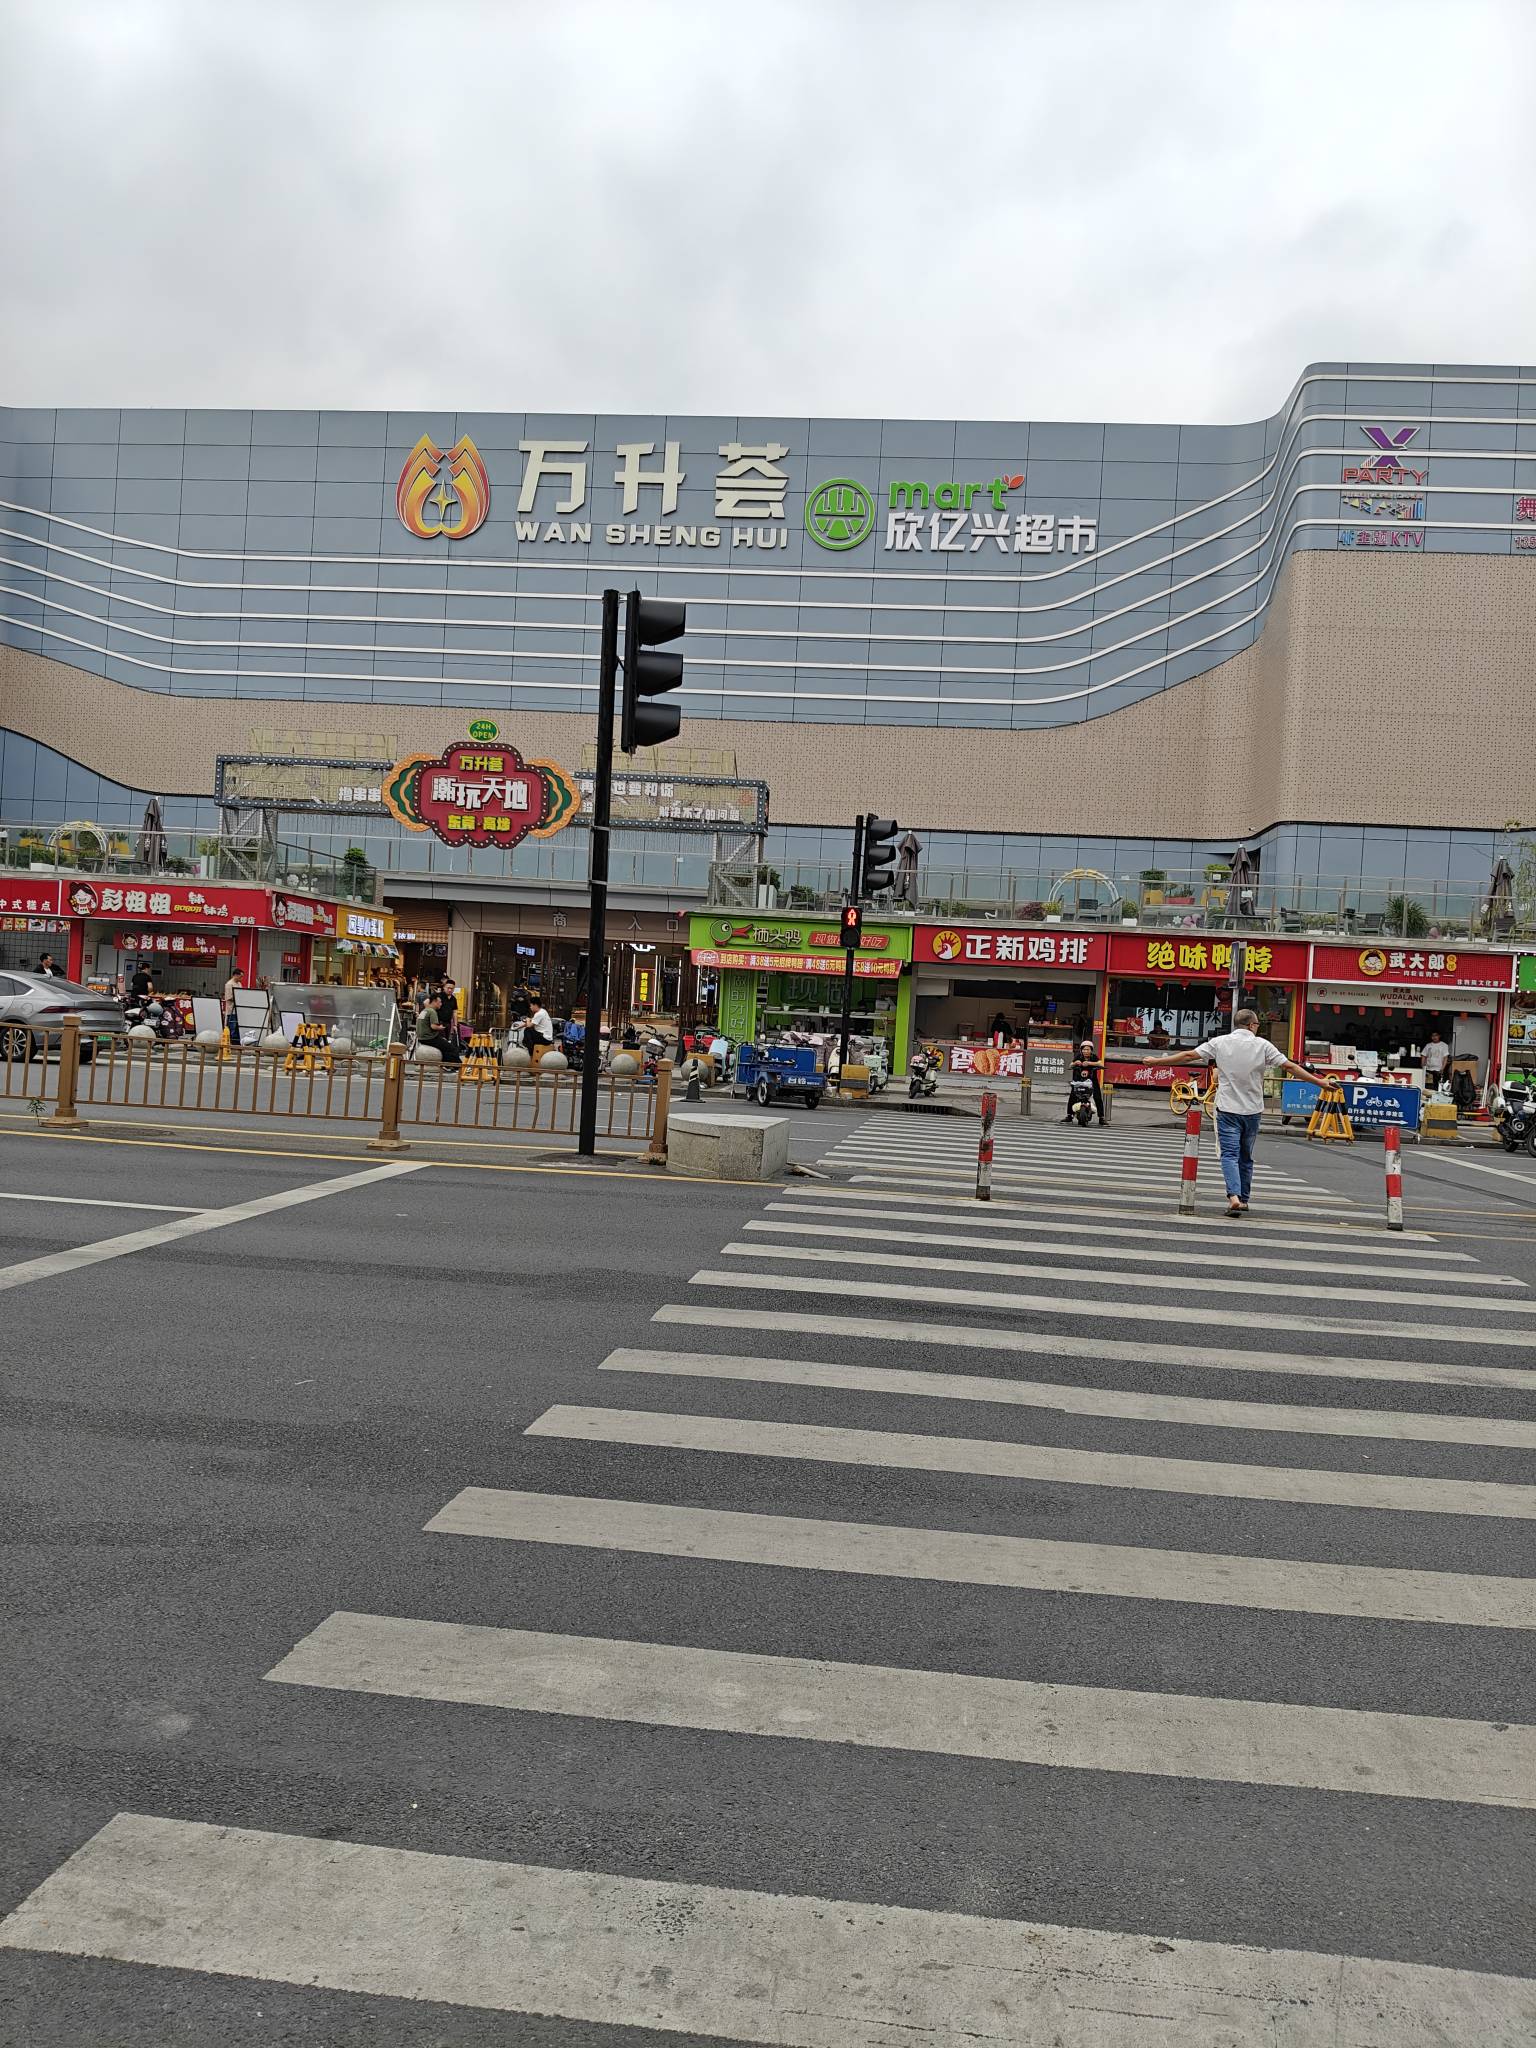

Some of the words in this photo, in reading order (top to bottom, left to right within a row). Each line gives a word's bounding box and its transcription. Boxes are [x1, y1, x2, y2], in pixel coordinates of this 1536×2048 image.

[517, 440, 790, 519] 万升荟
[1343, 468, 1428, 485] PARTY
[889, 477, 1008, 511] mart
[516, 521, 591, 543] WAN
[606, 524, 721, 547] SHENG
[733, 527, 789, 549] HUI
[884, 512, 1097, 554] 欣亿兴超市
[473, 731, 493, 739] OPEN
[460, 755, 503, 772] 万升荟
[432, 776, 528, 810] 潮玩天地
[101, 888, 171, 915] 彭姐姐
[966, 934, 1088, 964] 正新鸡排
[1147, 941, 1273, 975] 绝味鸭脖
[1389, 952, 1445, 971] 武大郎
[1379, 992, 1424, 1003] WUDALANG
[951, 1047, 975, 1070] 香
[999, 1052, 1023, 1075] 辣
[1034, 1065, 1064, 1074] 正新鸡排
[1299, 1089, 1306, 1099] P
[1352, 1087, 1368, 1105] P
[1347, 1107, 1365, 1115] 自行车
